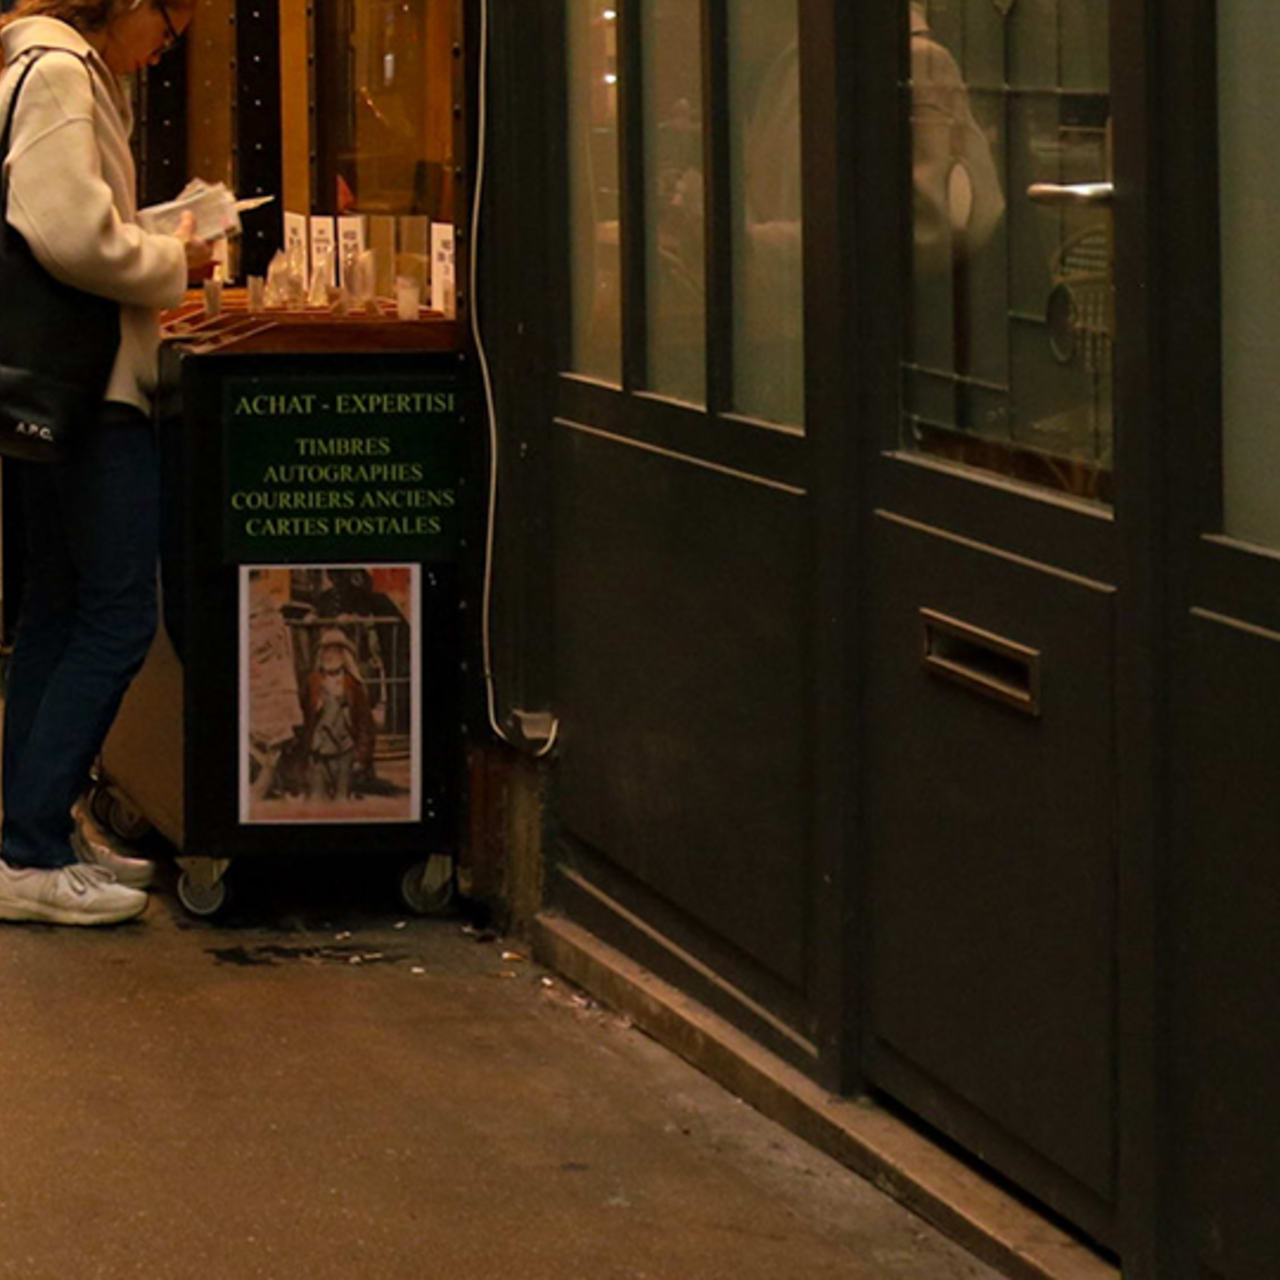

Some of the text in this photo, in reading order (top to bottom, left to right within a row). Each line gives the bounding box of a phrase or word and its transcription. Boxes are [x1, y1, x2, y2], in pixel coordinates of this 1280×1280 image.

[234, 393, 317, 416] ACHAT
[295, 436, 391, 457] TIMBRES
[262, 462, 424, 484] AUTOGRAPHES
[230, 488, 456, 511] COURRIERS ANCIENS
[244, 514, 442, 537] CARTES POSTALES
